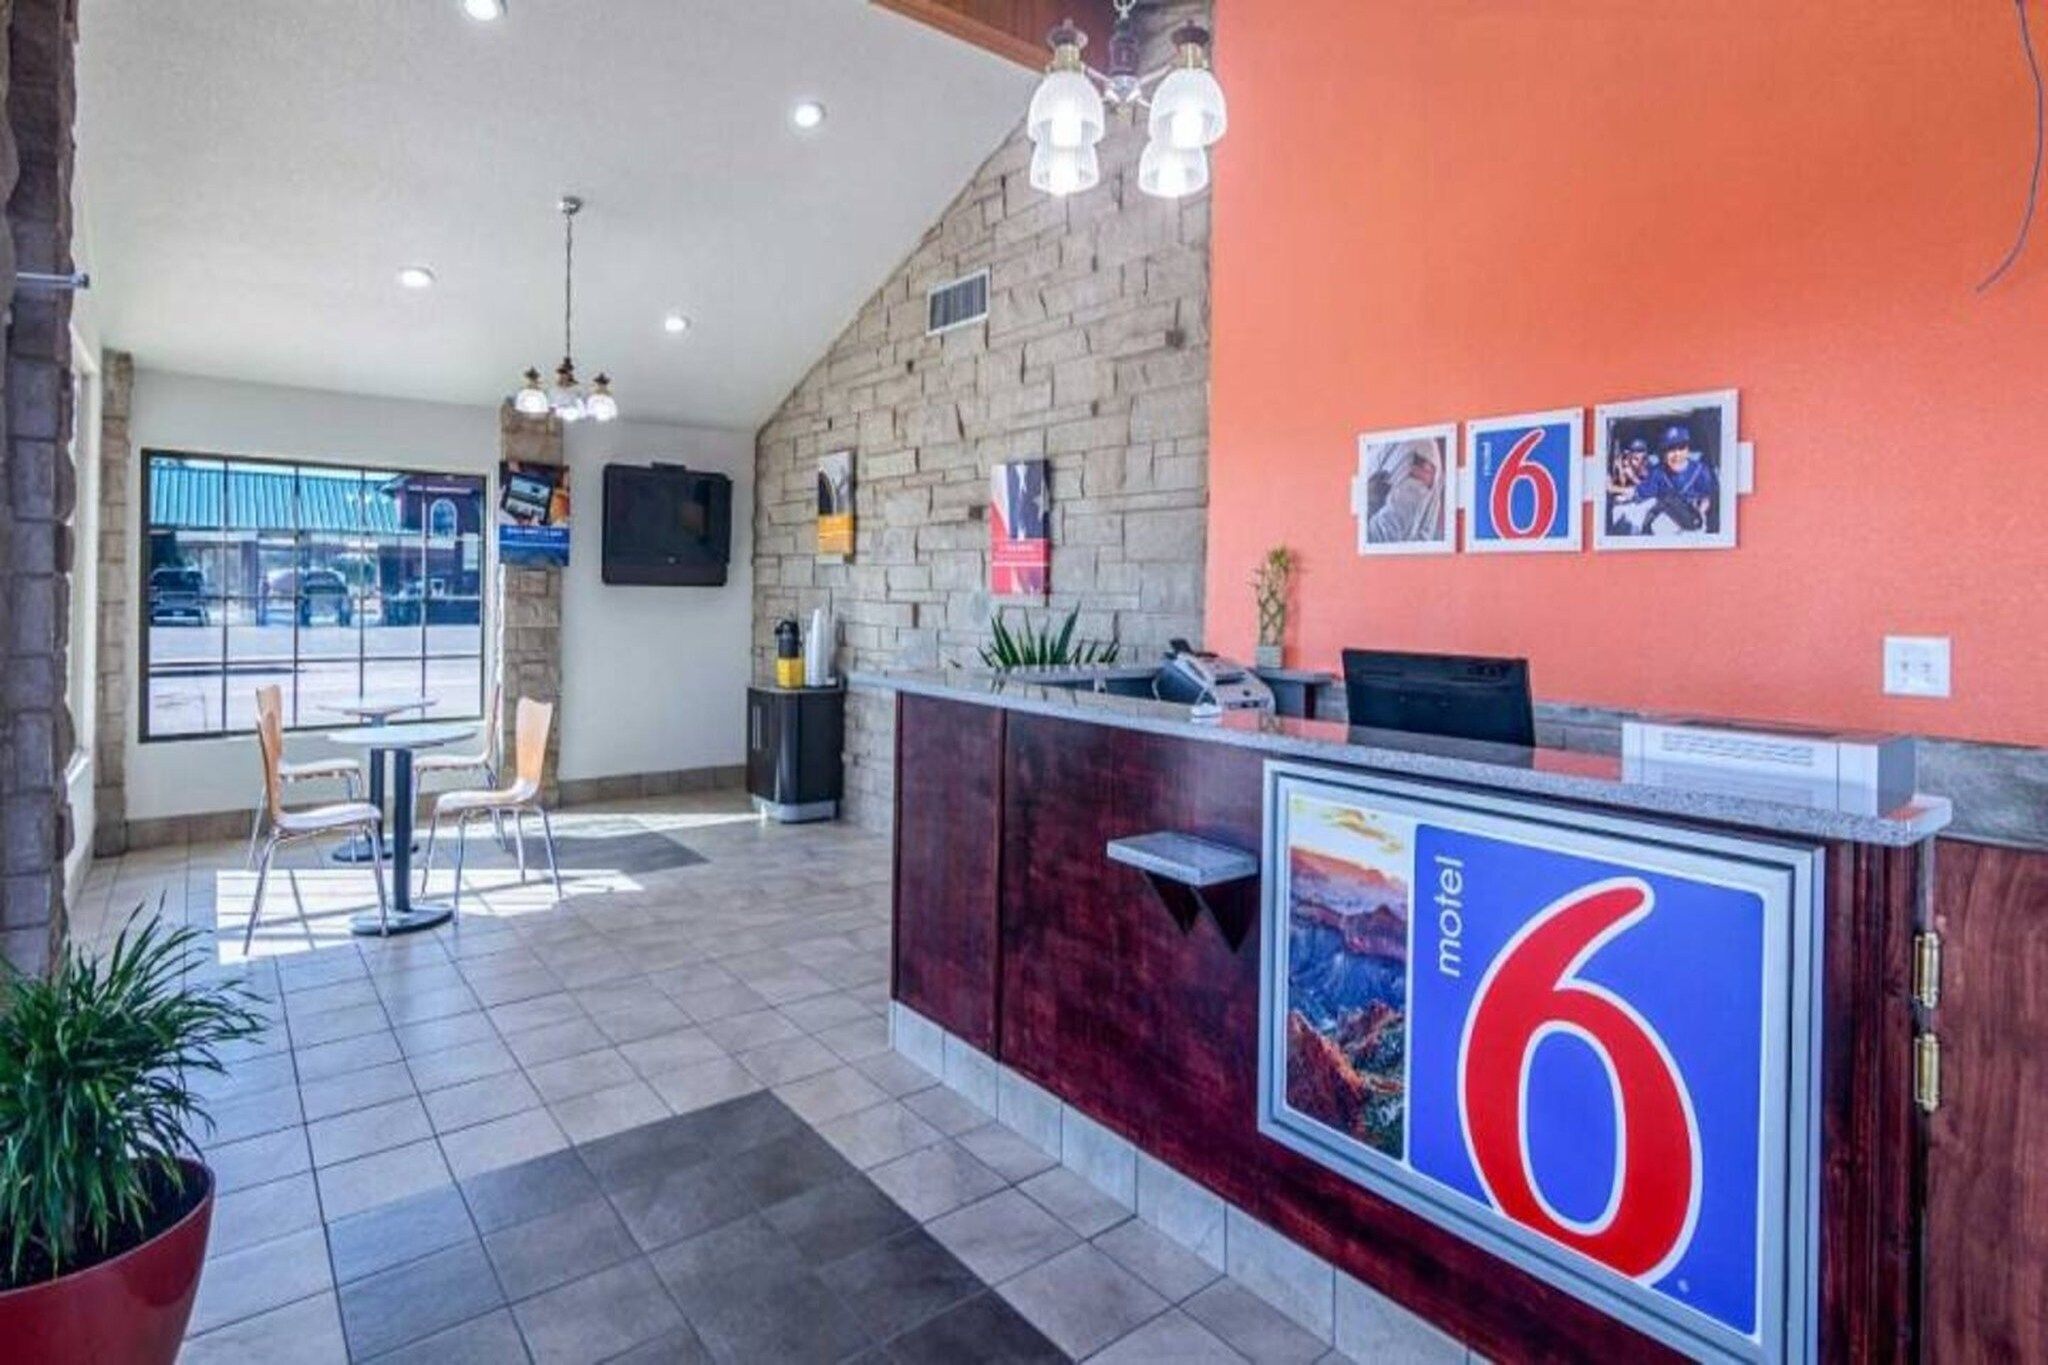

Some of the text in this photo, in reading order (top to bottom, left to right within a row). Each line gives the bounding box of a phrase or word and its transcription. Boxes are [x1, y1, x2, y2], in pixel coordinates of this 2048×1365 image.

[1490, 428, 1558, 540] 6
[1434, 855, 1464, 978] motel
[1457, 876, 1703, 1288] 6
